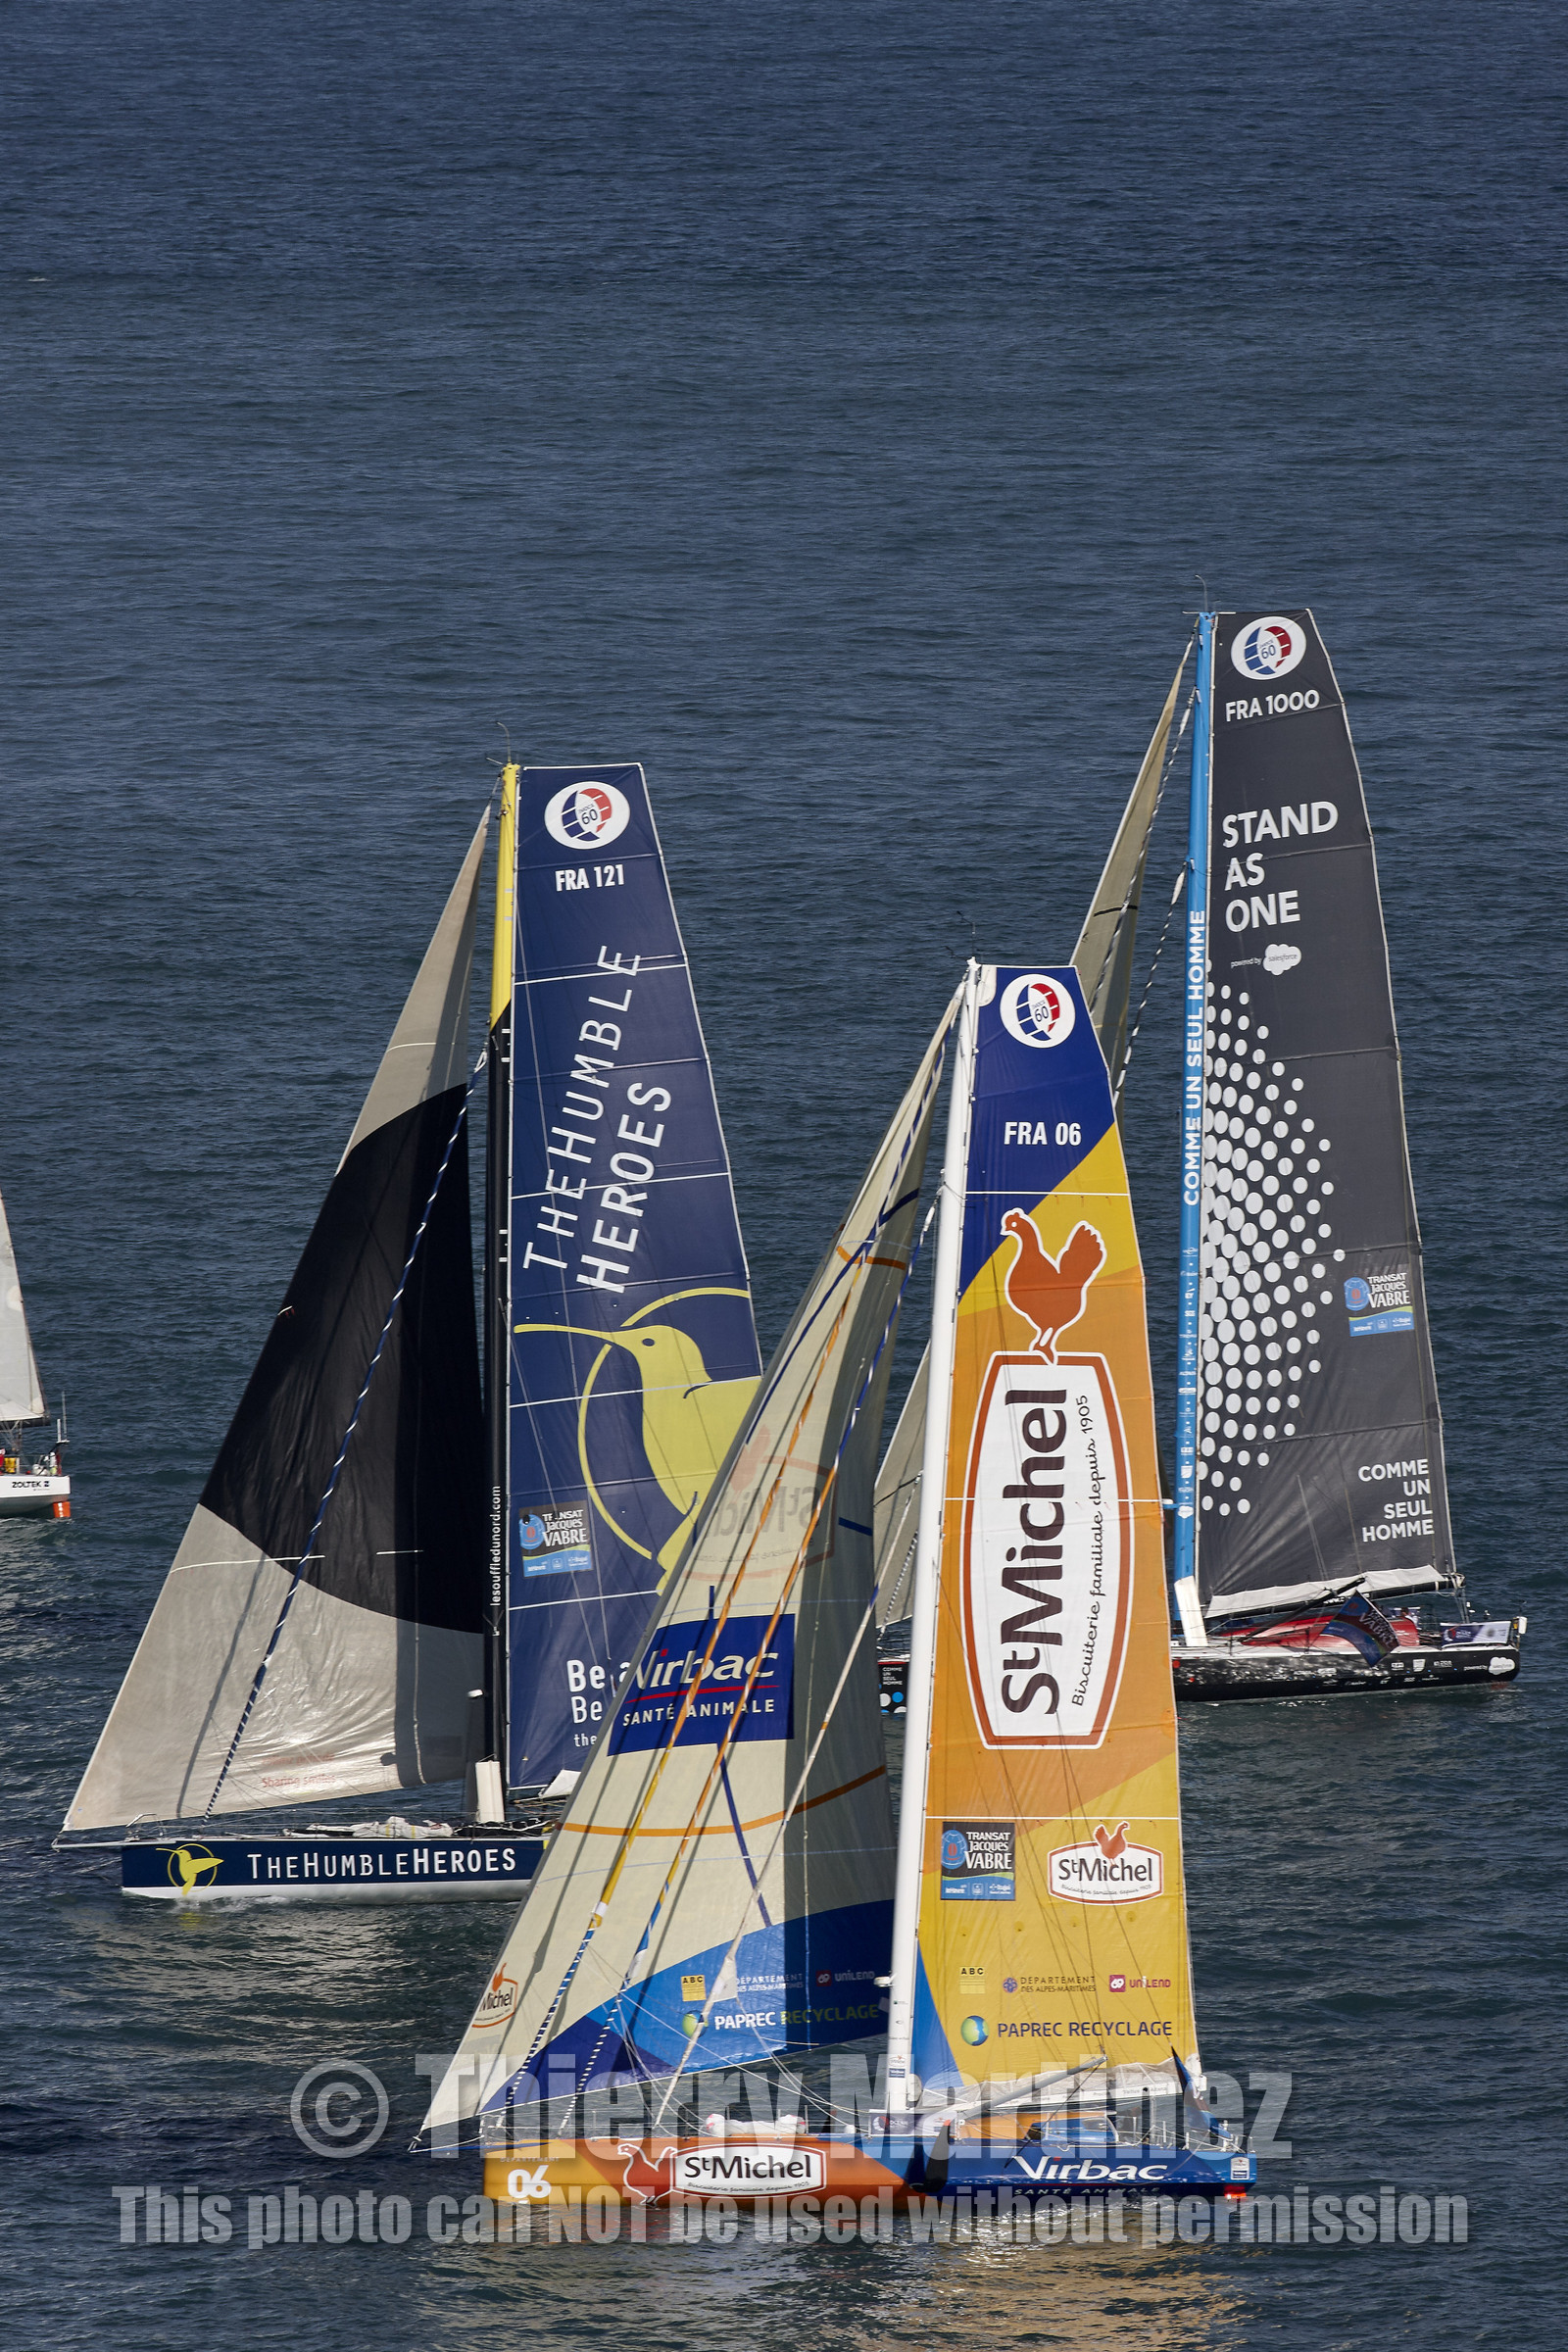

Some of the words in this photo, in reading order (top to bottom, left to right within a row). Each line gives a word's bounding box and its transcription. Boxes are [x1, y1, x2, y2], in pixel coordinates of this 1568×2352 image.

[1261, 645, 1276, 660] 60
[1225, 697, 1263, 721] FRA
[1265, 689, 1320, 714] 1000
[581, 808, 598, 824] 60
[1222, 801, 1339, 848] STAND
[555, 867, 590, 892] FRA
[594, 863, 625, 888] 121
[1224, 853, 1265, 891] AS
[1224, 890, 1301, 933] ONE
[1188, 910, 1205, 1001] HOMME
[1035, 1005, 1049, 1022] 60
[1186, 1006, 1203, 1067] SEUL
[1186, 1076, 1201, 1109] UN
[1004, 1121, 1048, 1146] FRA
[1054, 1121, 1082, 1147] 06
[1183, 1117, 1201, 1206] COMME
[576, 1082, 672, 1294] HEROES
[1367, 1272, 1407, 1284] TRANSAT
[1367, 1290, 1411, 1309] VABRE
[1076, 1395, 1094, 1434] 1905
[1088, 1438, 1106, 1506] depuis
[1357, 1458, 1430, 1482] COMME
[1402, 1478, 1432, 1496] UN
[1383, 1499, 1434, 1519] SEUL
[542, 1528, 589, 1547] VABRE
[1361, 1518, 1436, 1543] HOMME
[490, 1486, 501, 1606] lesouffledunord.com
[1090, 1510, 1107, 1597] familiale
[1071, 1600, 1101, 1706] Biscuiterie
[566, 1659, 606, 1692] Be
[636, 1648, 779, 1690] Virbac
[570, 1695, 603, 1724] Be
[622, 1703, 675, 1727] SANTÉ
[685, 1698, 775, 1718] ANIMALE
[966, 1832, 1011, 1840] TRANSAT
[964, 1850, 1012, 1869] VABRE
[713, 2012, 776, 2030] PAPREC
[780, 2003, 879, 2025] RECYCLAGE
[998, 2022, 1063, 2037] PAPREC
[1068, 2021, 1173, 2036] RECYCLAGE
[507, 2164, 552, 2199] 06
[1012, 2155, 1168, 2181] Virbac
[1013, 2186, 1071, 2195] SANTÉ
[1081, 2185, 1160, 2195] ANIMALE
